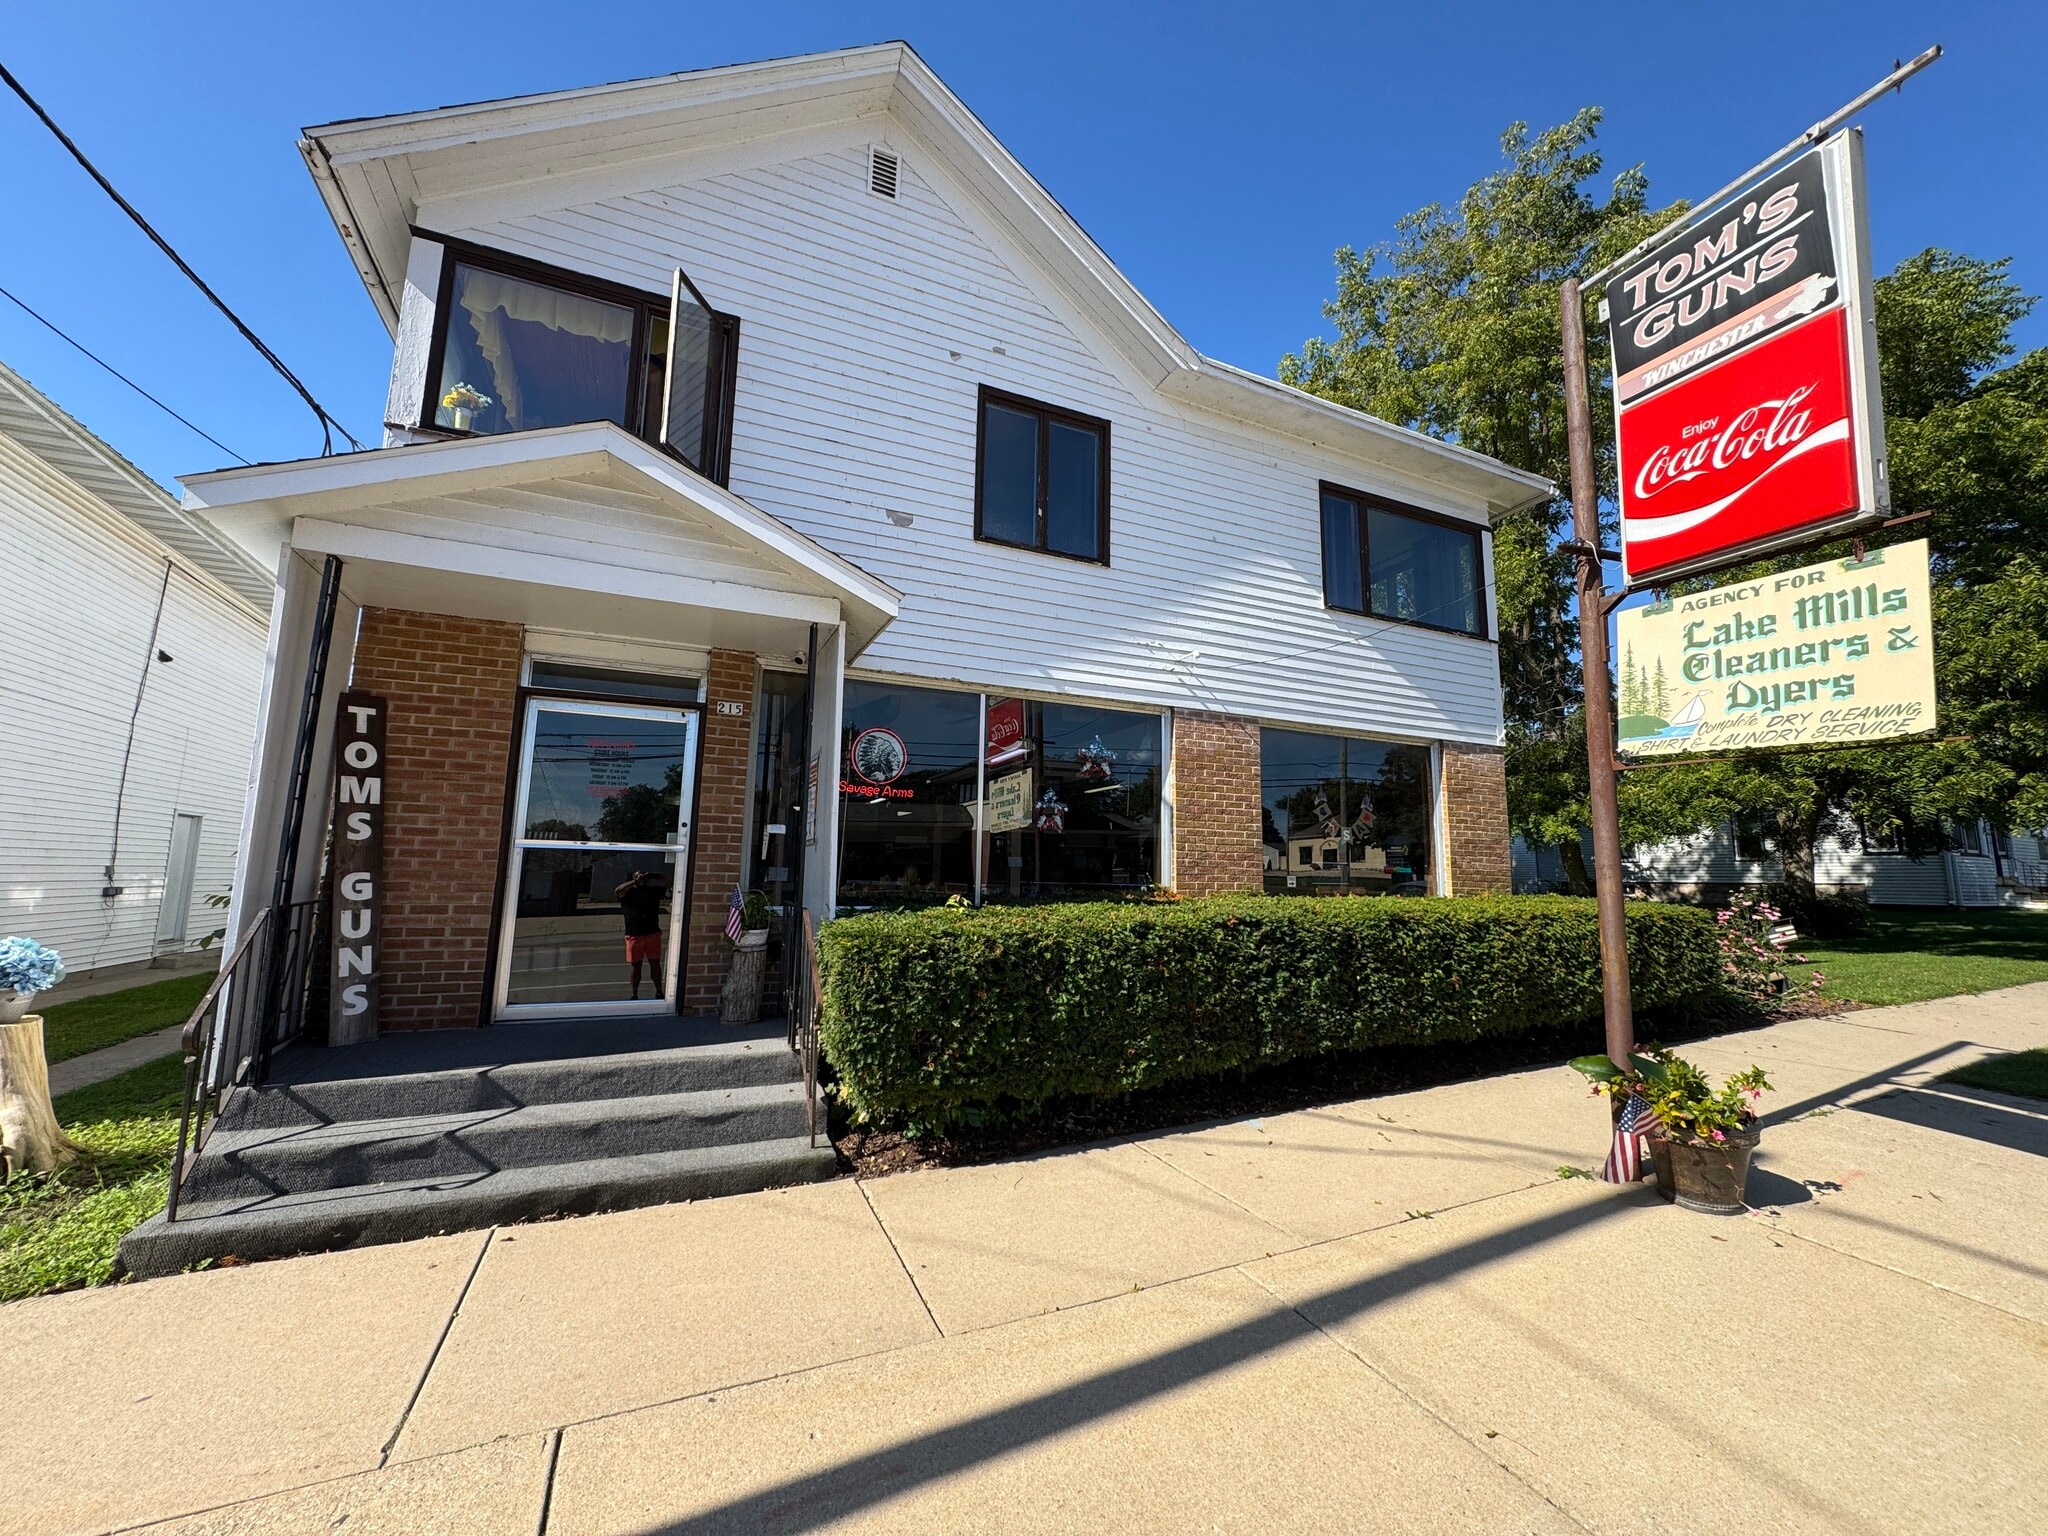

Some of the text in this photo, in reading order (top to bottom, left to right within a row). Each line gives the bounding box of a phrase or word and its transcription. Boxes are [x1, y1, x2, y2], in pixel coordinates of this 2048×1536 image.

[1624, 183, 1799, 311] TOM'S
[1633, 234, 1799, 348] GUNS
[1642, 314, 1768, 388] WINCHESTER
[1634, 380, 1820, 499] Coca-Cola
[1682, 415, 1720, 440] Enjoy
[1681, 570, 1826, 614] AGENCY FOR
[1683, 583, 1908, 654] Lake Mills
[1682, 625, 1919, 683] Cleaners &
[718, 702, 742, 715] 215
[1725, 674, 1856, 715] Dyers
[1638, 717, 1916, 752] SHIRT & LAUNDRY SERVICE
[1697, 710, 1758, 735] Complete
[1766, 713, 1810, 728] DRY
[839, 780, 914, 798] Savage Arms
[338, 705, 381, 1016] TOMS GUNS
